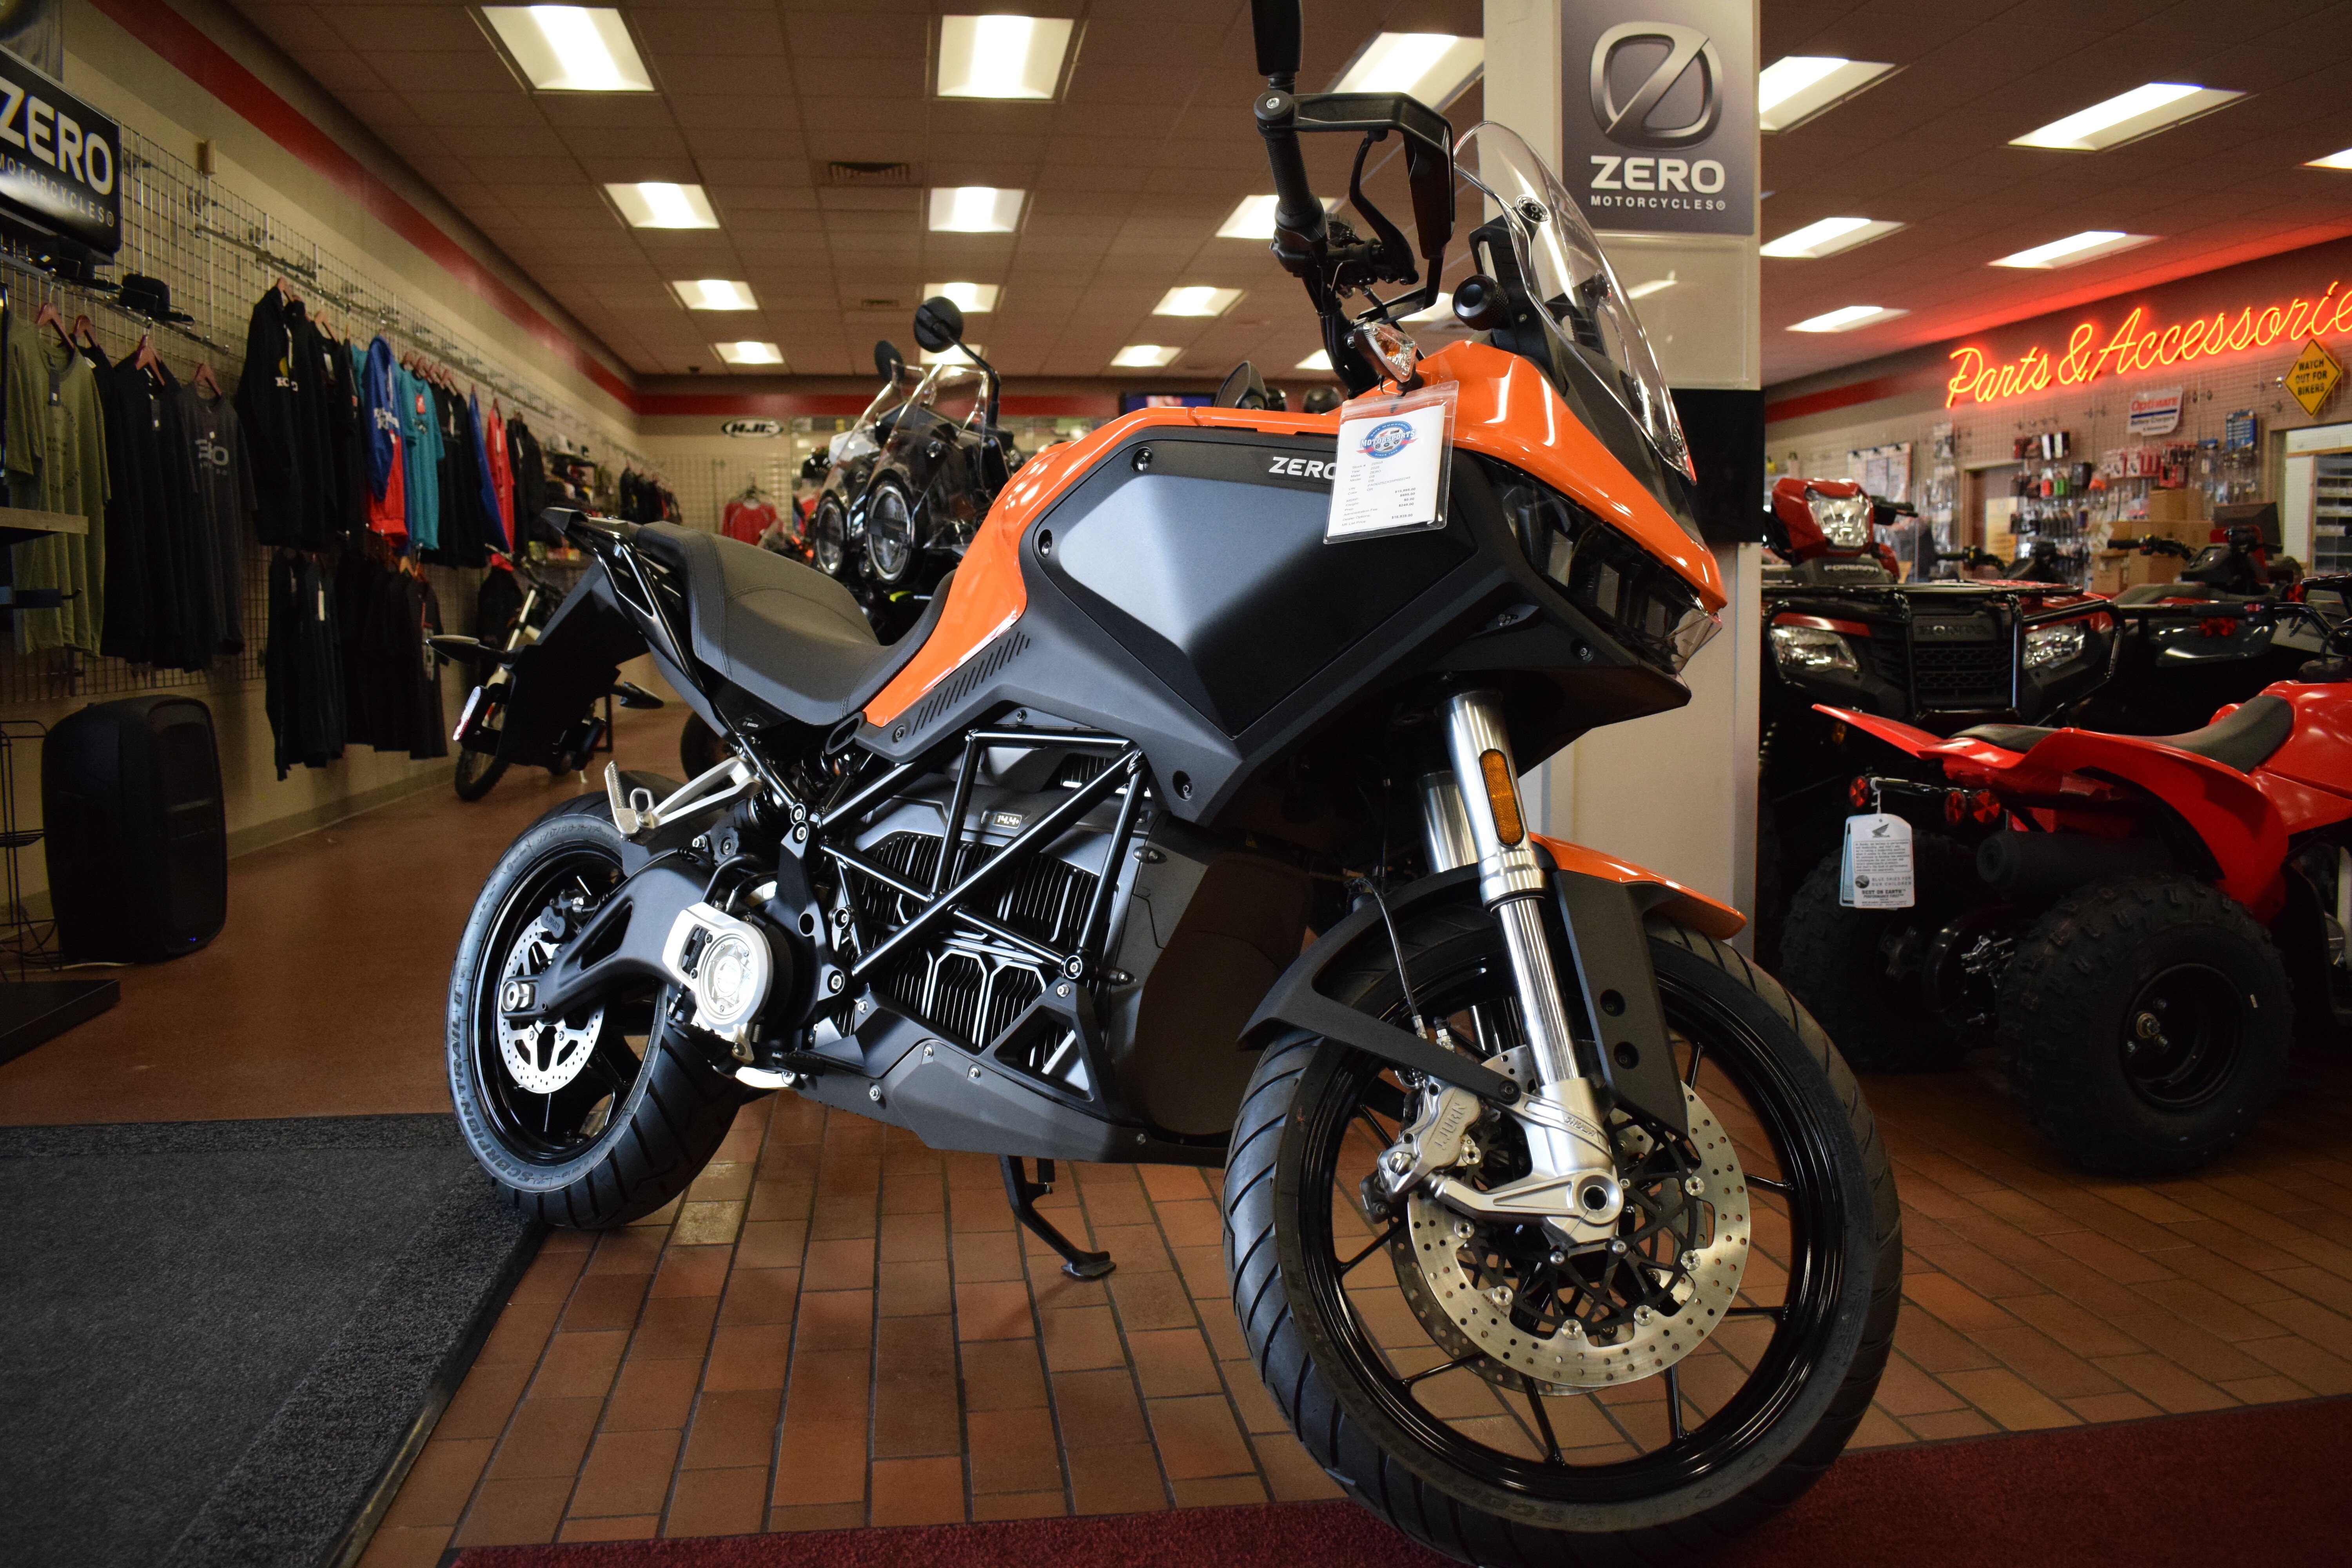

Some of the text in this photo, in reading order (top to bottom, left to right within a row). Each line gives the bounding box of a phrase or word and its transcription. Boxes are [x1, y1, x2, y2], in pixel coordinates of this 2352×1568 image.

[0, 76, 113, 196] ZERO
[1590, 155, 1726, 194] ZERO
[1946, 347, 2051, 409] Parts
[2058, 323, 2093, 386] &
[2298, 358, 2324, 371] WATCH
[2295, 370, 2327, 384] OUT FOR
[2297, 383, 2325, 396] BIKERS
[1360, 429, 1416, 448] MOTORSPORTS
[1269, 456, 1336, 479] ZERO
[451, 1015, 466, 1093] TRAIL
[1564, 1116, 1596, 1136] SHOWA
[460, 1101, 534, 1182] SCORPION
